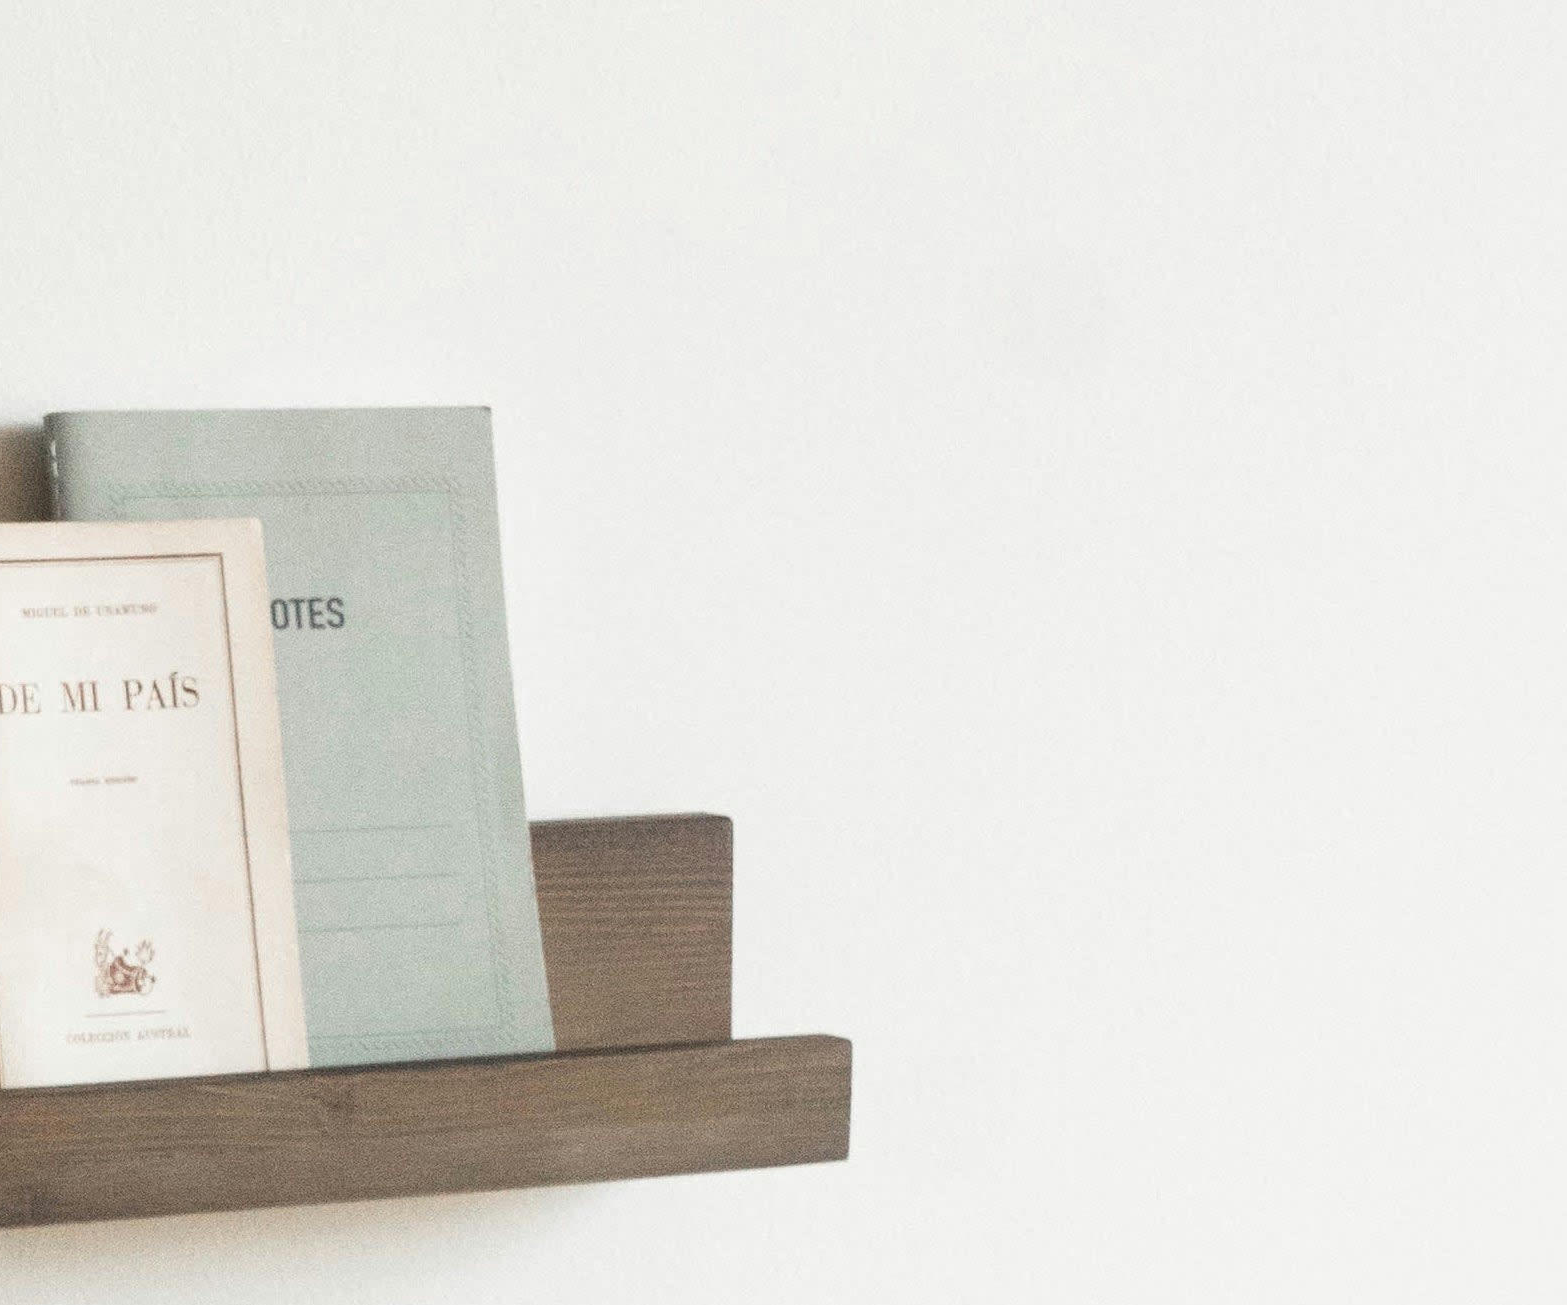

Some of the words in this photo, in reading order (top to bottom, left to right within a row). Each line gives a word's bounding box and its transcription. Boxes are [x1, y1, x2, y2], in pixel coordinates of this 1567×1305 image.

[20, 606, 69, 619] MIGUEL
[73, 605, 91, 618] DE
[270, 597, 345, 630] OTES
[60, 680, 103, 713] MI
[122, 671, 201, 711] PAÍS
